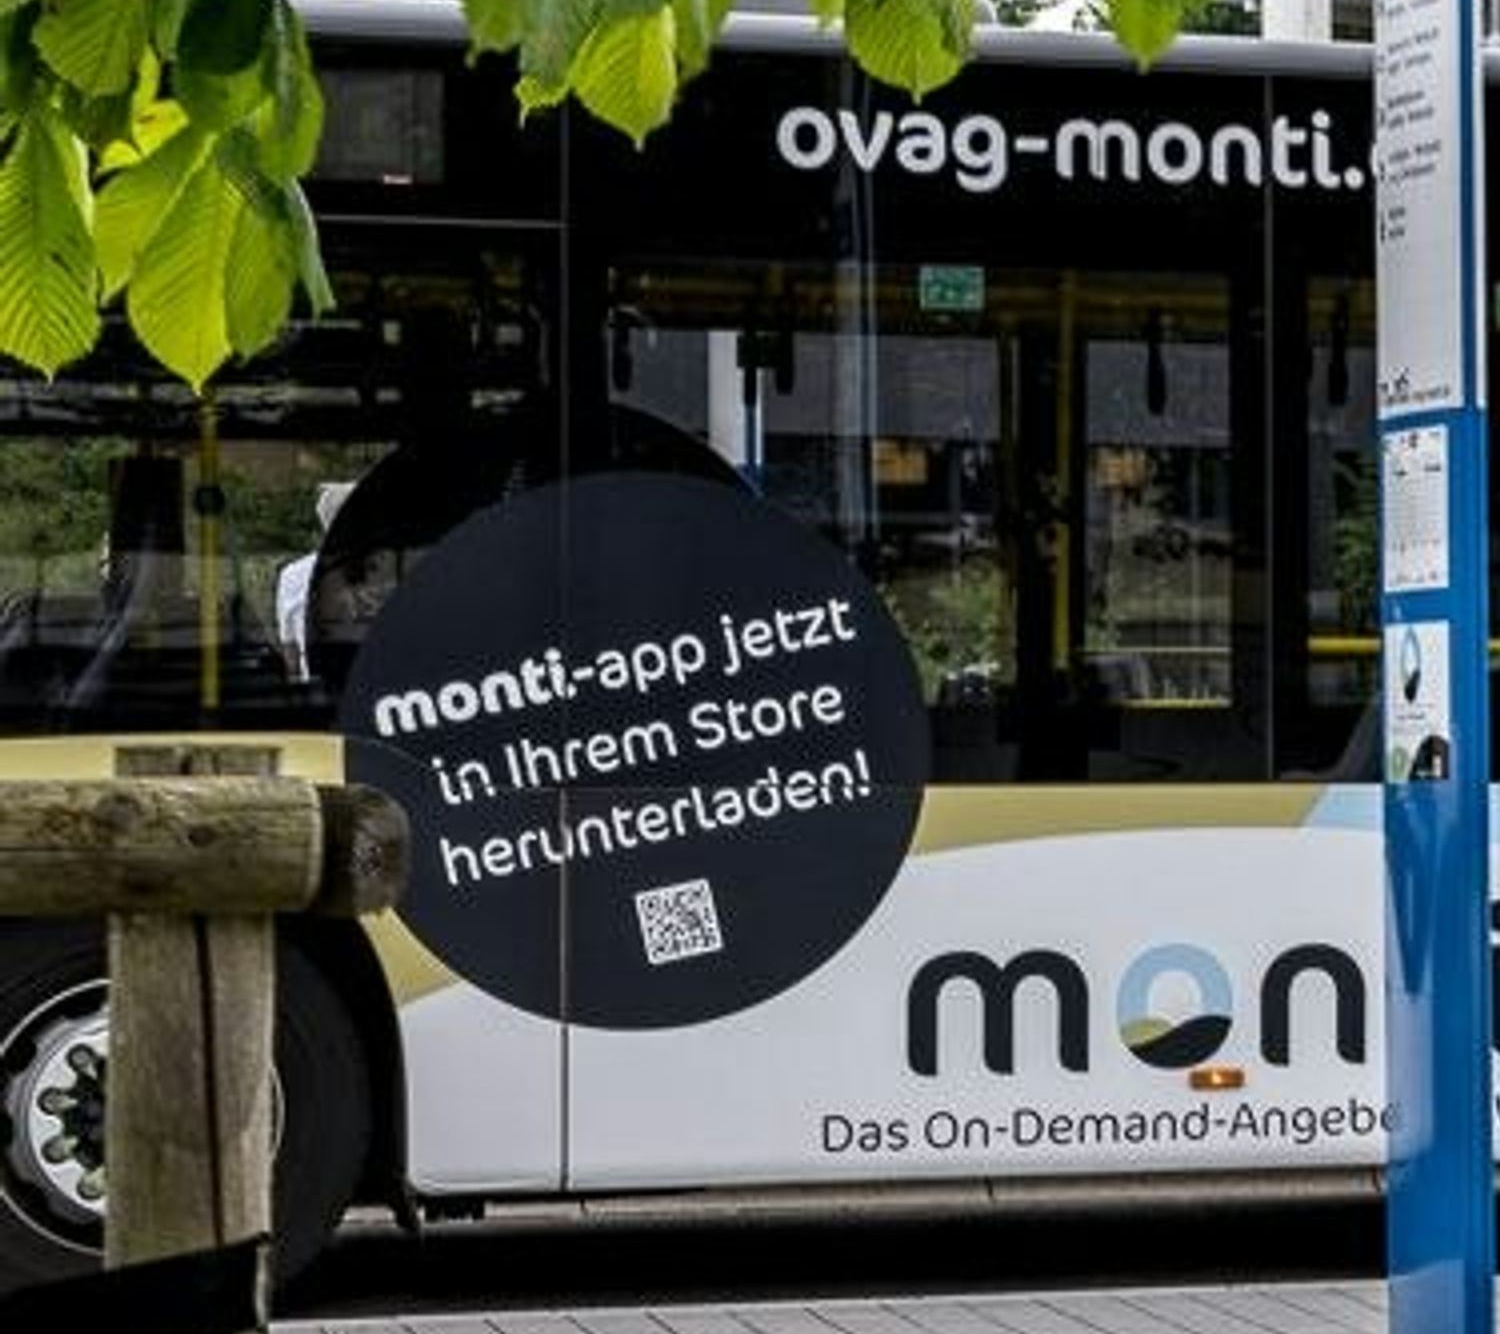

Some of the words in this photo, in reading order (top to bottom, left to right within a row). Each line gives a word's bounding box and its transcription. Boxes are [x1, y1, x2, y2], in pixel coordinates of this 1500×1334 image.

[776, 108, 1377, 193] ovag-monti.
[374, 631, 706, 739] monti-app
[720, 596, 857, 675] jetzt
[431, 755, 496, 807] in
[506, 717, 678, 791] Ihrem
[693, 685, 846, 751] Store
[439, 749, 872, 887] herunterladen!
[821, 1113, 910, 1154] Das
[924, 1098, 1391, 1154] On-Demand-Angeb
